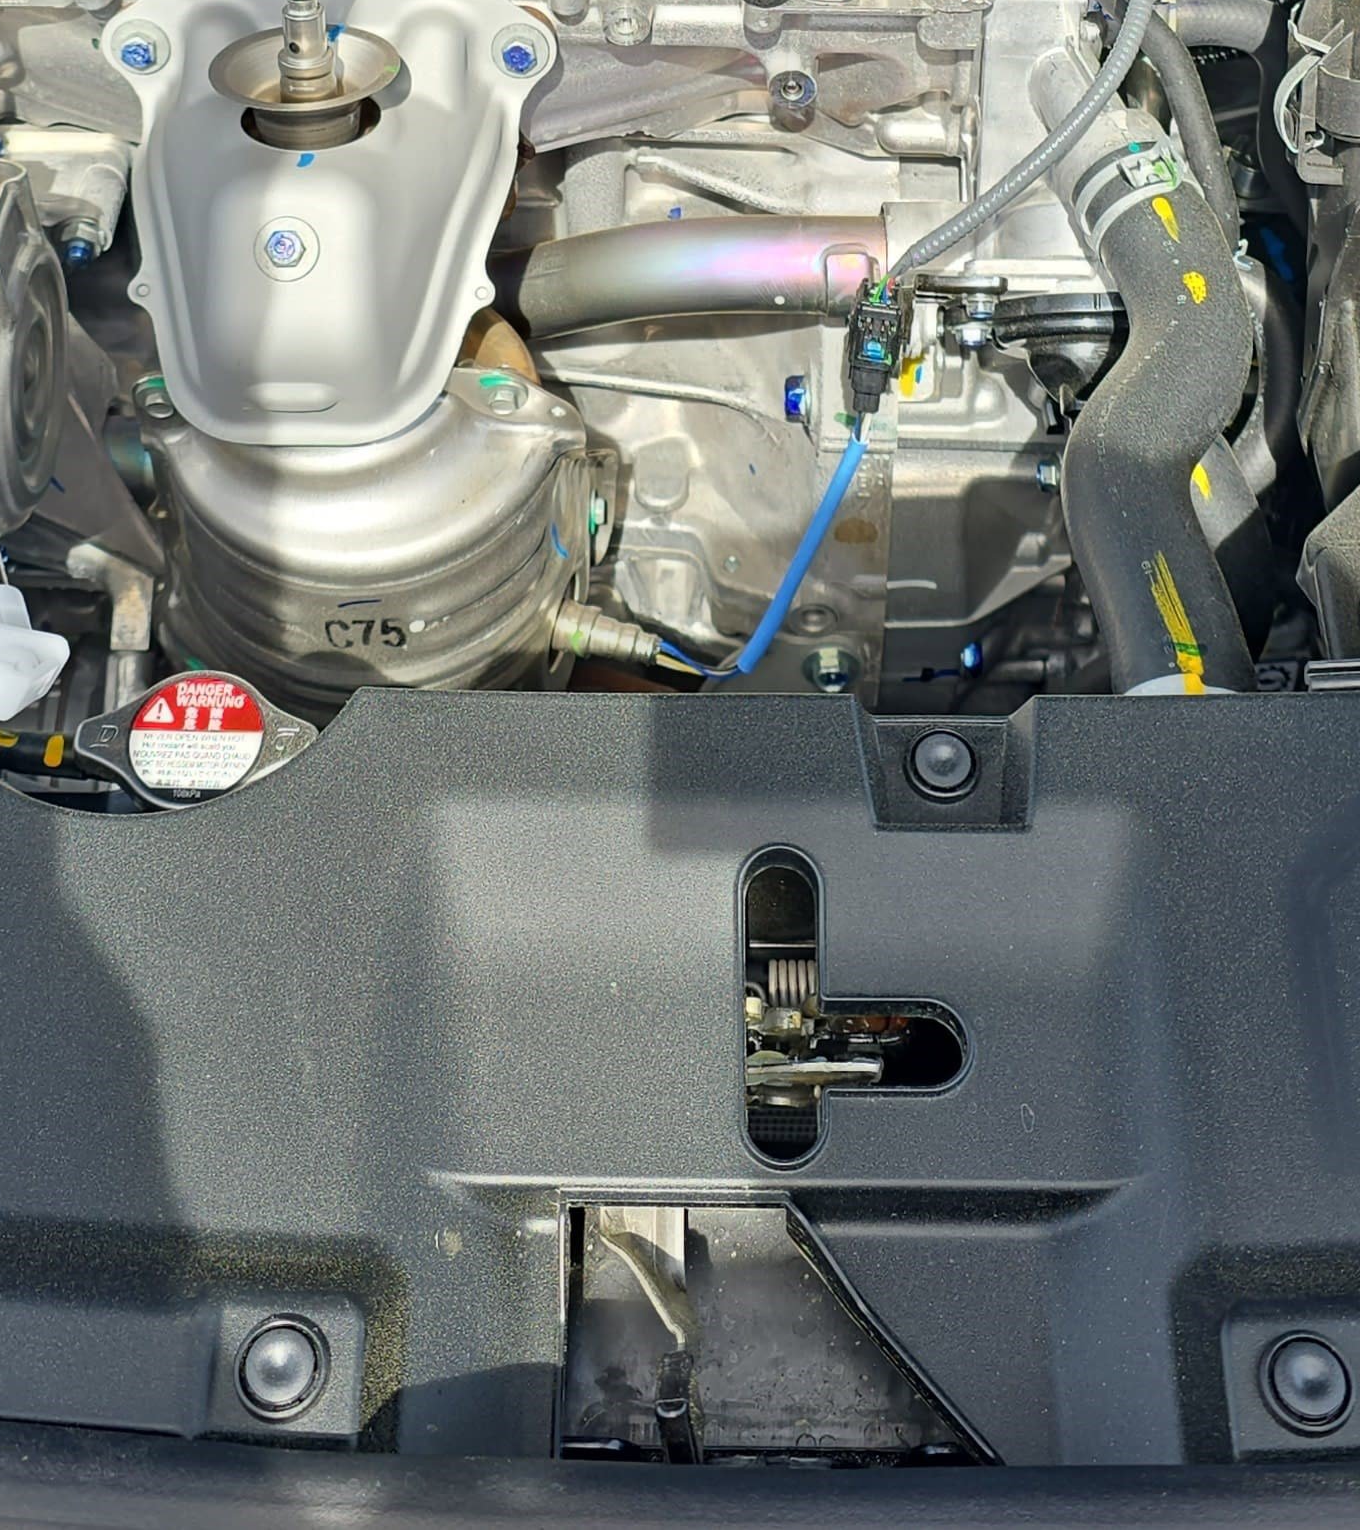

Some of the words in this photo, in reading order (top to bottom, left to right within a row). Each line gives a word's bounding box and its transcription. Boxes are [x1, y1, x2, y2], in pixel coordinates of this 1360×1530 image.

[325, 618, 406, 648] C75
[177, 683, 233, 695] DANGER
[177, 694, 246, 709] WARNUNG
